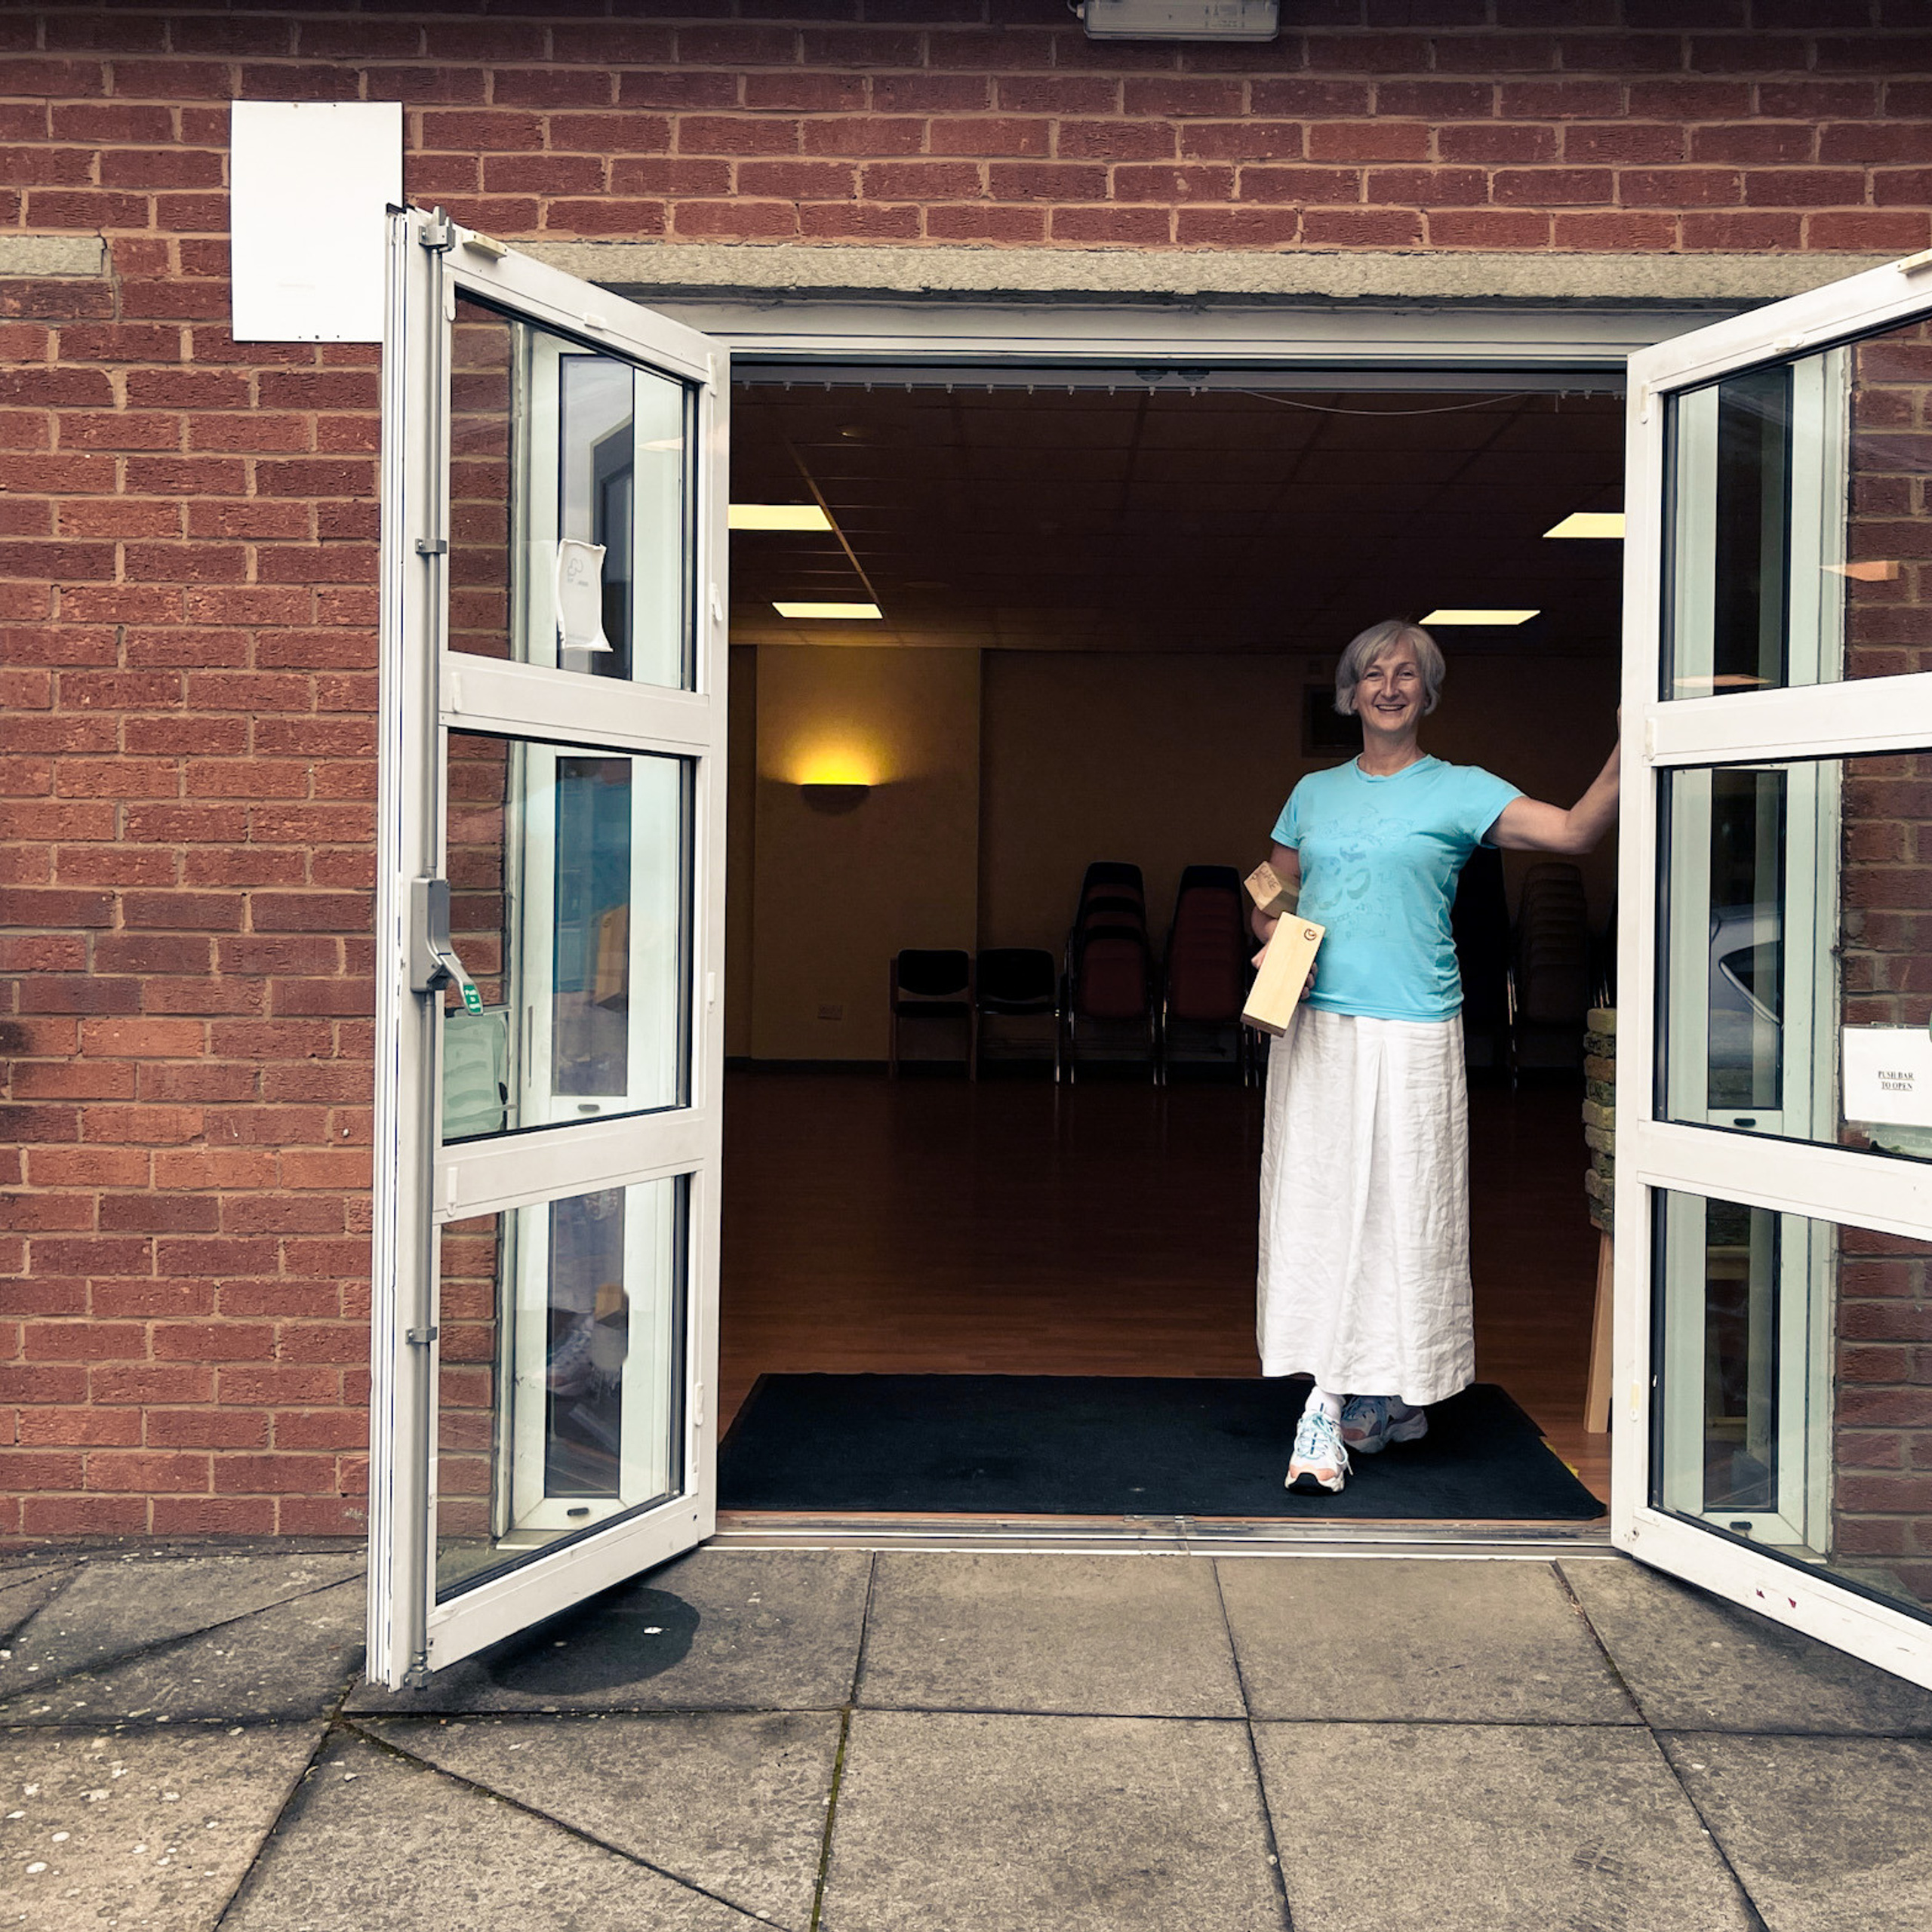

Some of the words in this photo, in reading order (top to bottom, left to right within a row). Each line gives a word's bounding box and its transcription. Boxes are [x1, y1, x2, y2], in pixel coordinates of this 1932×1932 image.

[1878, 1071, 1896, 1080] PUSH
[1898, 1072, 1914, 1080] BAR
[1881, 1081, 1891, 1091] TO
[1892, 1082, 1913, 1091] OPEN
